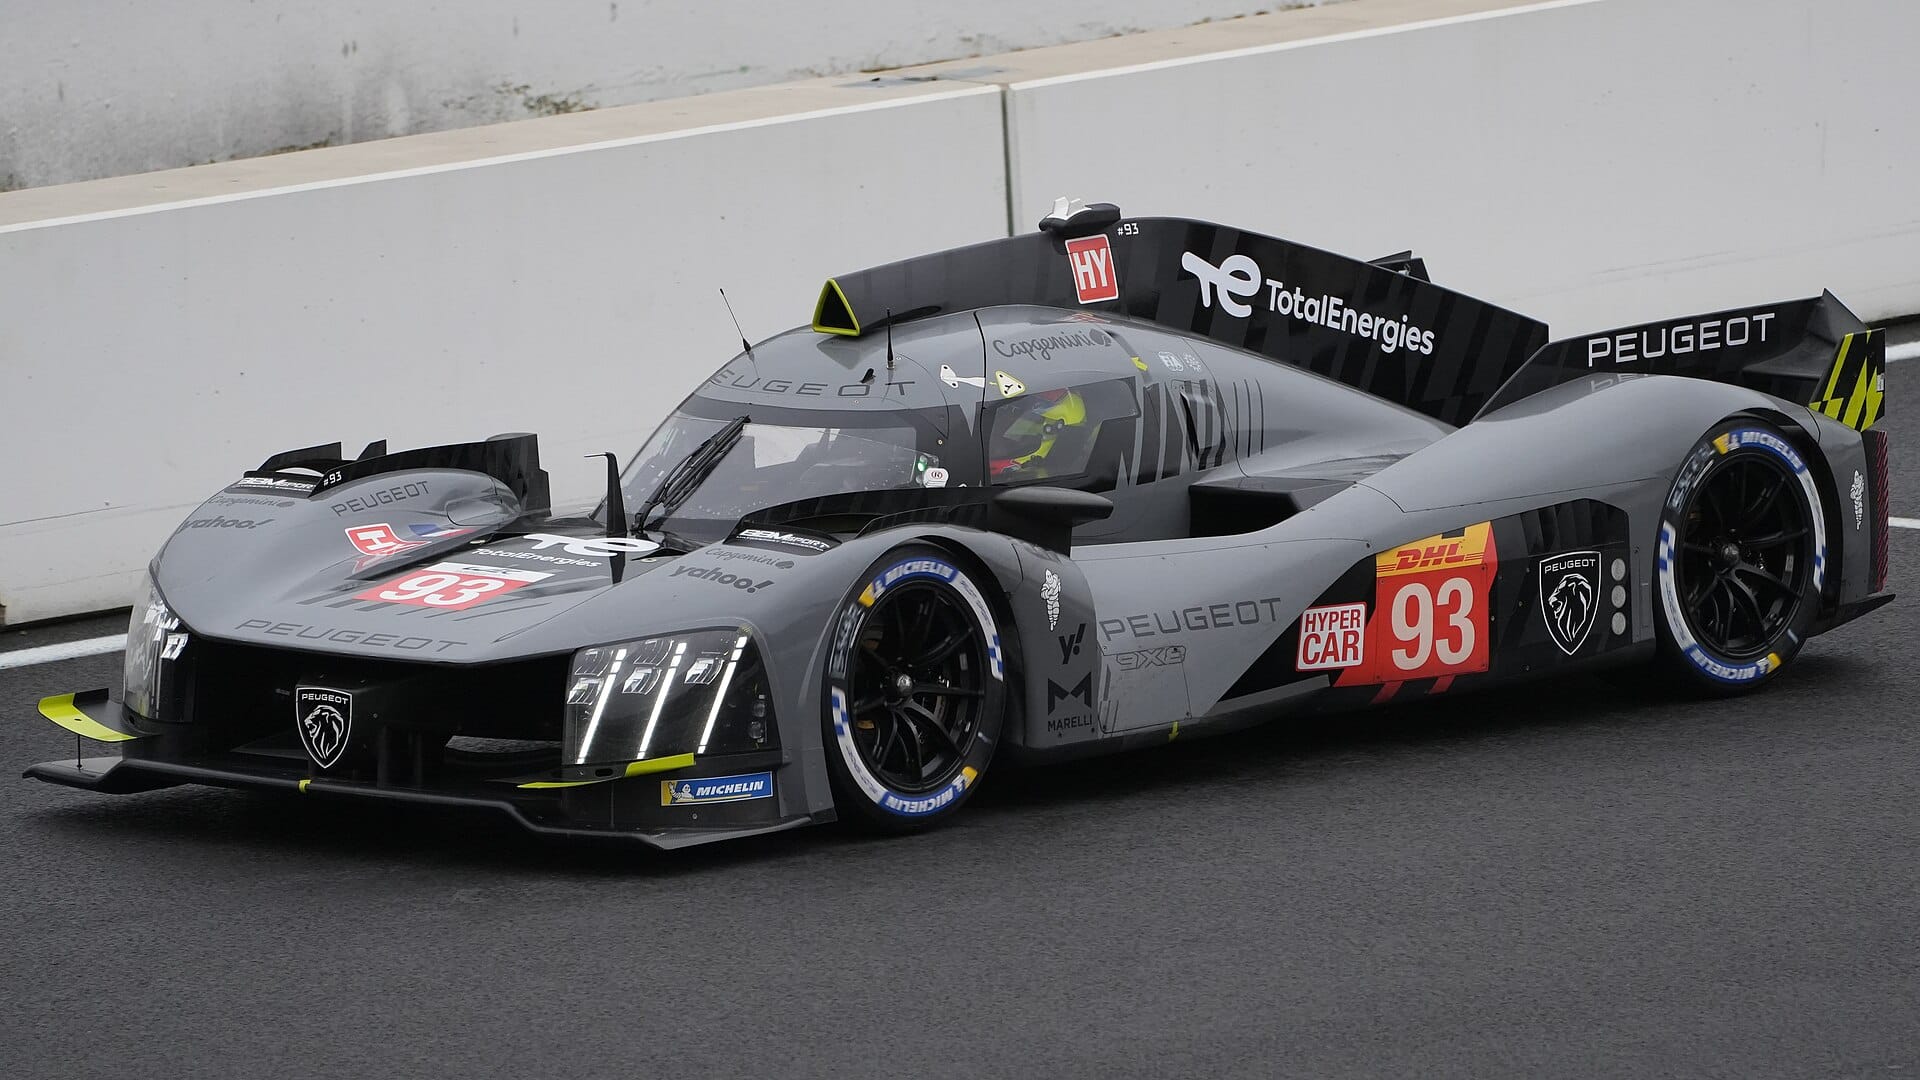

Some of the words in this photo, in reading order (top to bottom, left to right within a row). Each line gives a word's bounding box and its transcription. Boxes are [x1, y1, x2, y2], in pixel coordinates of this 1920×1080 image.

[1117, 222, 1139, 236] #93
[1072, 248, 1109, 291] HY
[1266, 278, 1435, 355] TotalEnergies
[993, 331, 1092, 360] Capgemini
[1588, 312, 1776, 367] PEUGEOT
[705, 369, 916, 397] EUGEOT
[323, 471, 342, 486] #93
[331, 481, 430, 516] PEUGEOT
[176, 515, 275, 534] yahoo!
[472, 549, 602, 567] TotalEnergies
[705, 548, 777, 568] Capgemini
[1396, 541, 1468, 571] DHL
[1544, 558, 1596, 574] PEUGEOT
[669, 565, 775, 594] yahoo!
[884, 560, 954, 586] MICHELIN
[379, 574, 506, 605] 93
[1100, 597, 1281, 641] PEUGEOT
[1304, 608, 1362, 633] HYPER
[1391, 577, 1476, 671] 93
[235, 619, 468, 652] PEUGEOT
[1302, 631, 1360, 665] CAR
[301, 693, 349, 706] PEUGEOT
[1048, 714, 1093, 732] MARELLI
[695, 779, 765, 798] MICHELIN
[885, 786, 954, 813] MICHELIN
